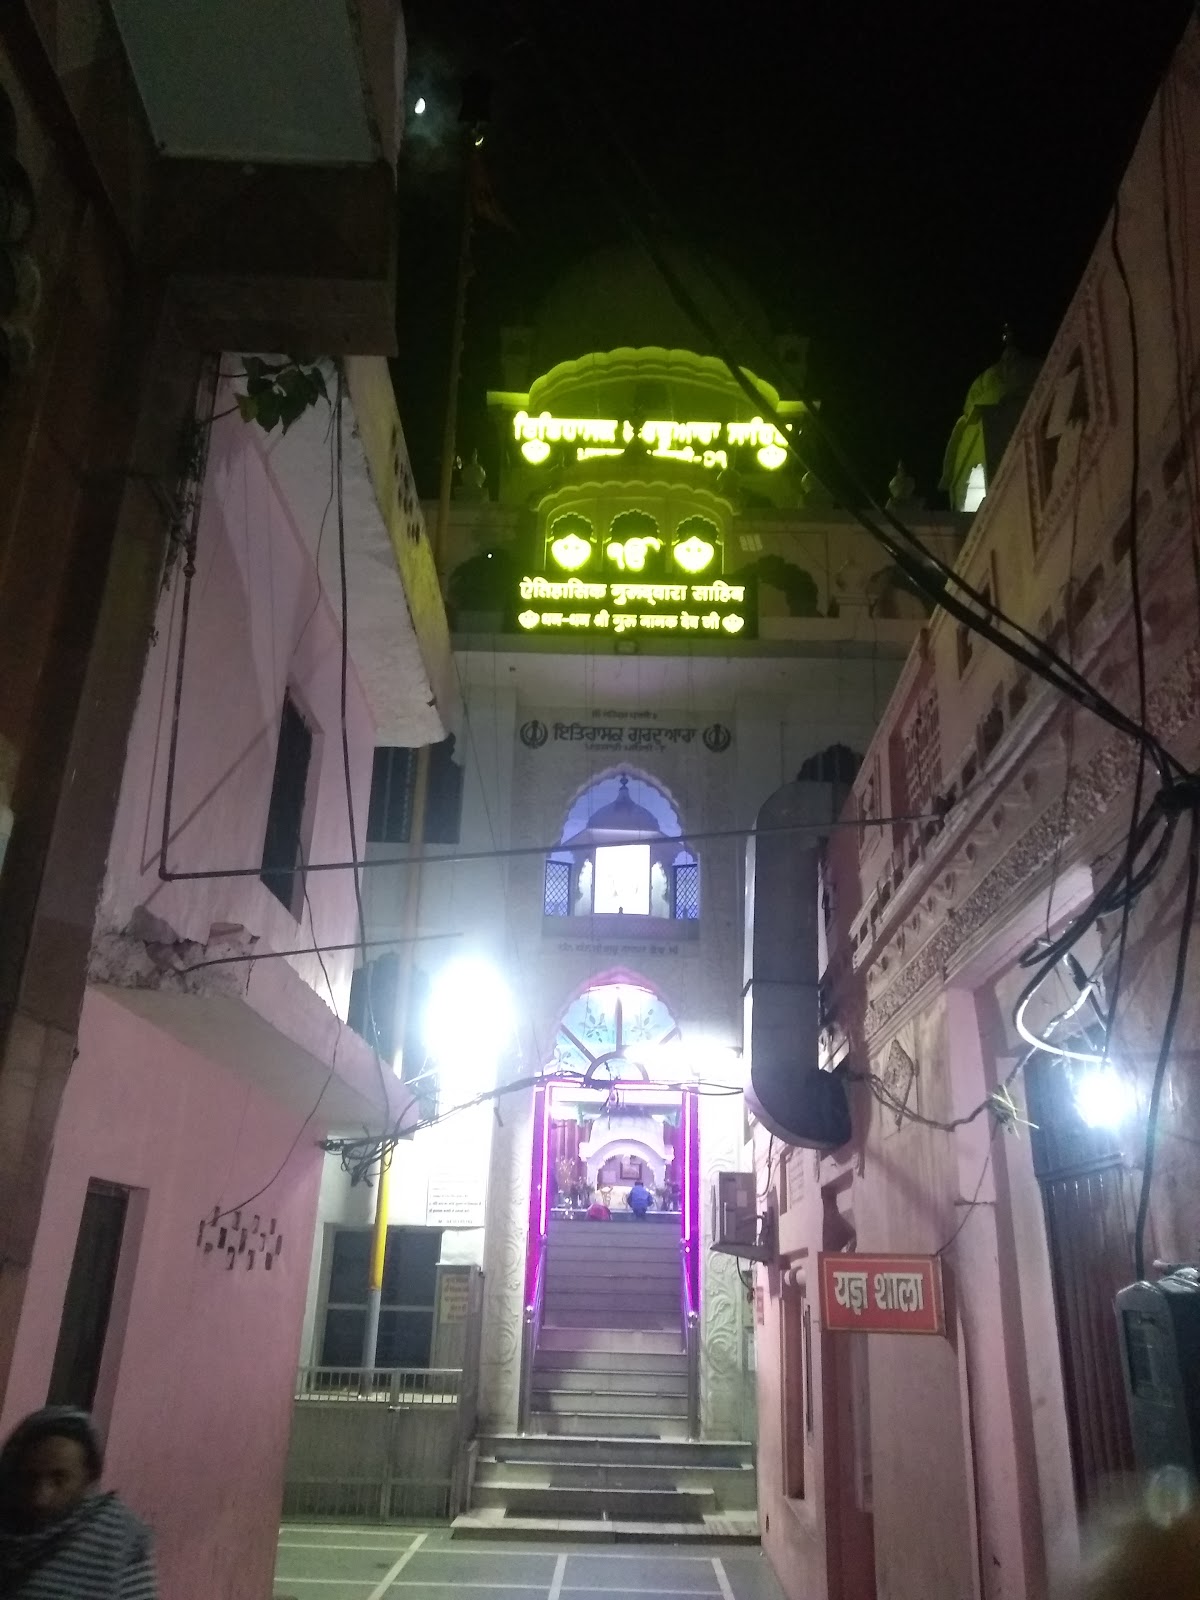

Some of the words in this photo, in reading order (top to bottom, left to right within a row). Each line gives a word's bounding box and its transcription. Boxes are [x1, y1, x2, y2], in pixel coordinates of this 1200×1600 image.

[519, 576, 607, 600] ऐतिहासिक
[690, 580, 745, 602] साहिब
[639, 615, 678, 628] नानक
[680, 611, 700, 628] देव
[701, 611, 721, 628] जी
[833, 1271, 868, 1316] यज्ञ
[873, 1273, 923, 1312] शाला
